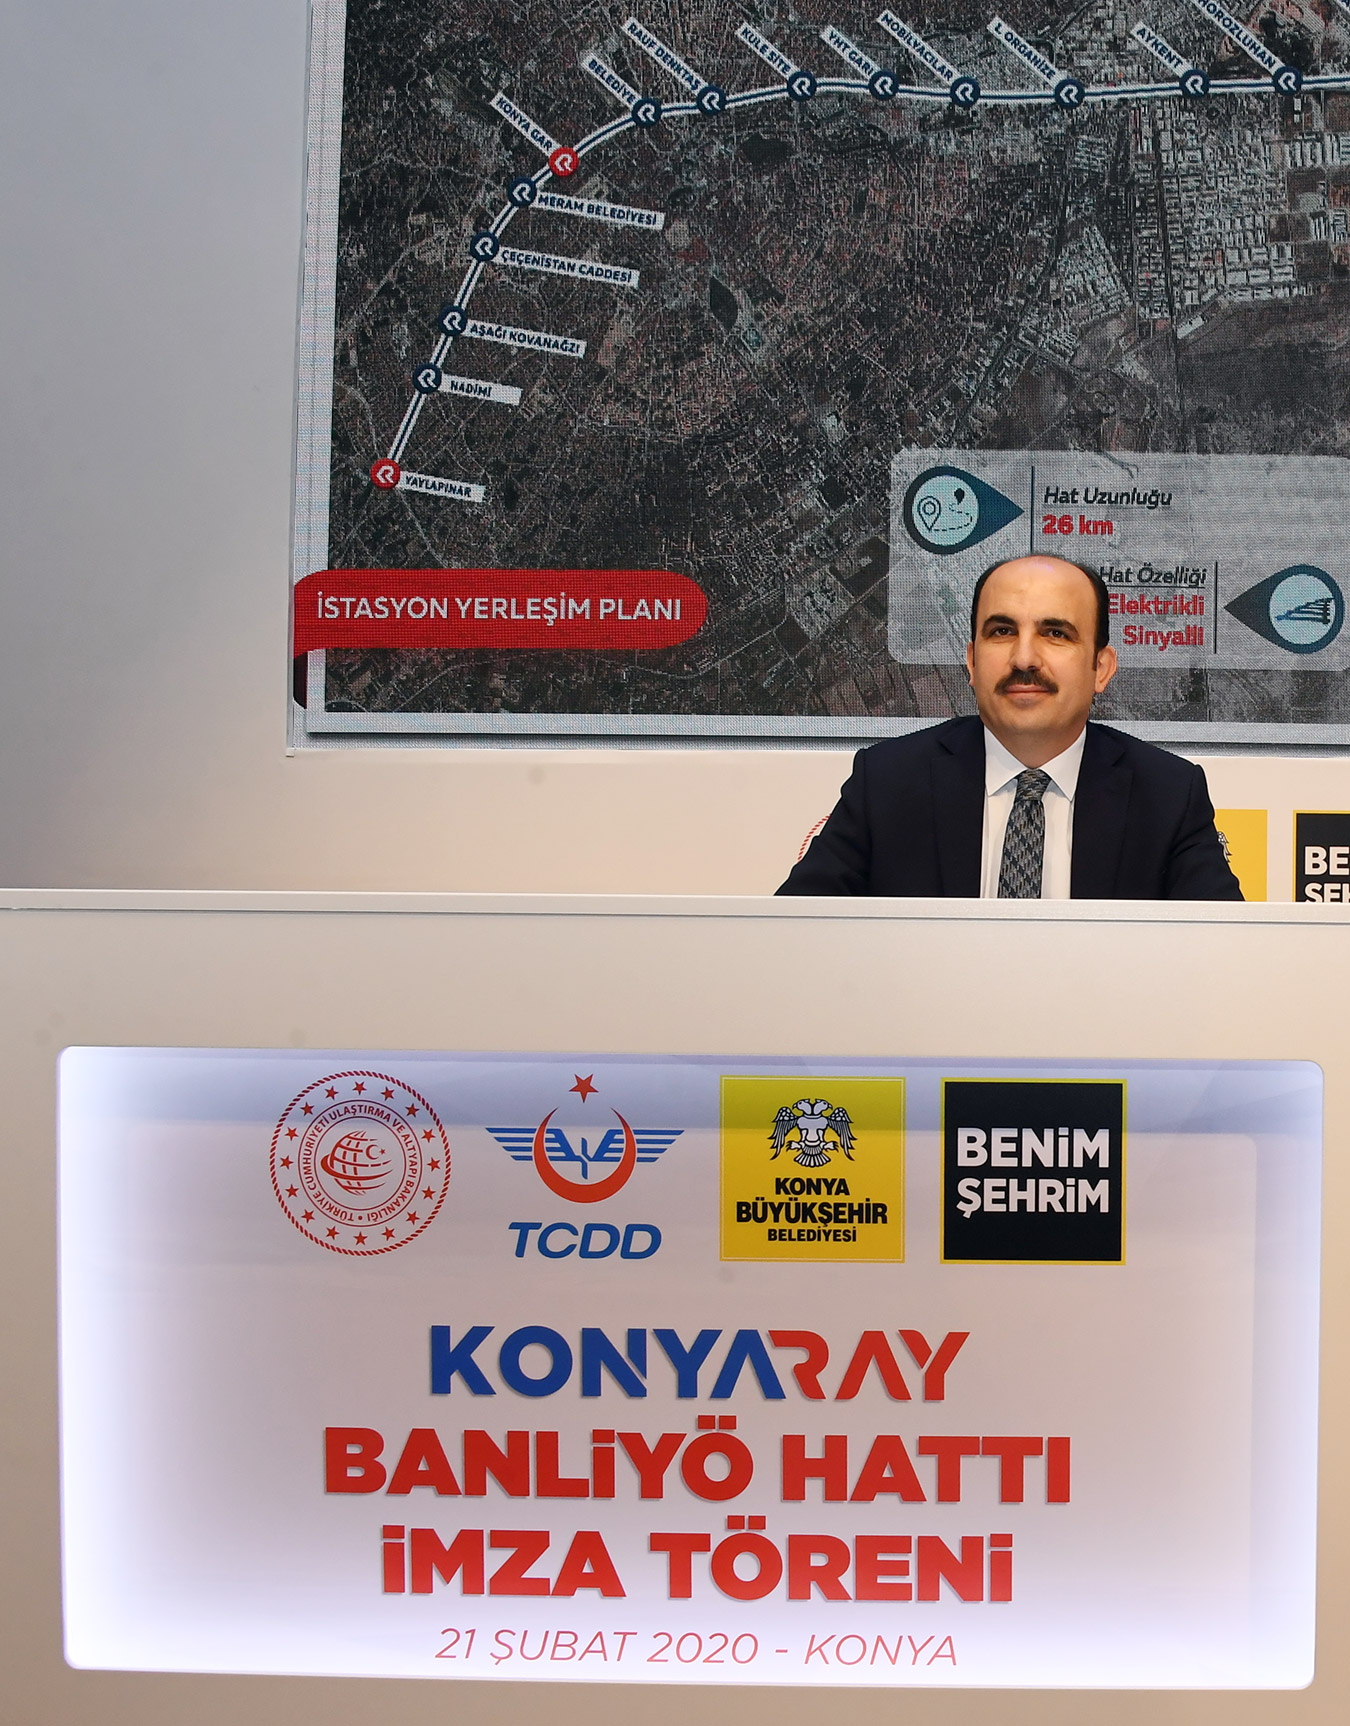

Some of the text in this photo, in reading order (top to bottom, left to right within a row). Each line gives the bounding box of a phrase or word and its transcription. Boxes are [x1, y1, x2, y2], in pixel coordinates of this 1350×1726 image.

[628, 22, 655, 55] RAUF
[741, 26, 768, 54] KULE
[1136, 27, 1183, 68] AYKENT
[1201, 0, 1276, 68] OROZLUMAN
[828, 31, 874, 75] YHT GARI
[497, 97, 552, 151] KONYA GAR
[538, 194, 584, 212] MERAM
[1044, 486, 1173, 510] Hat Uzunluğu
[1042, 515, 1114, 535] 26 km
[1100, 562, 1207, 586] Hat Özelliği
[317, 591, 681, 627] İSTASYON YERLEŞİM PLANI
[1108, 593, 1204, 615] Elektrikli
[330, 1104, 391, 1123] ULAŞTIRMA
[392, 1118, 406, 1133] VE
[401, 1133, 418, 1179] ALTYAPI
[775, 1176, 850, 1197] KONYA
[736, 1195, 888, 1229] BÜYÜKŞEHİR
[508, 1222, 661, 1259] TCDD
[767, 1225, 857, 1242] BELEDİYESİ
[429, 1325, 970, 1401] KONYARAY
[782, 1434, 1071, 1503] HATTI
[435, 1627, 476, 1659] 21
[490, 1628, 637, 1664] ŞUBAT
[647, 1632, 760, 1664] 2020
[804, 1634, 958, 1666] KONYA
